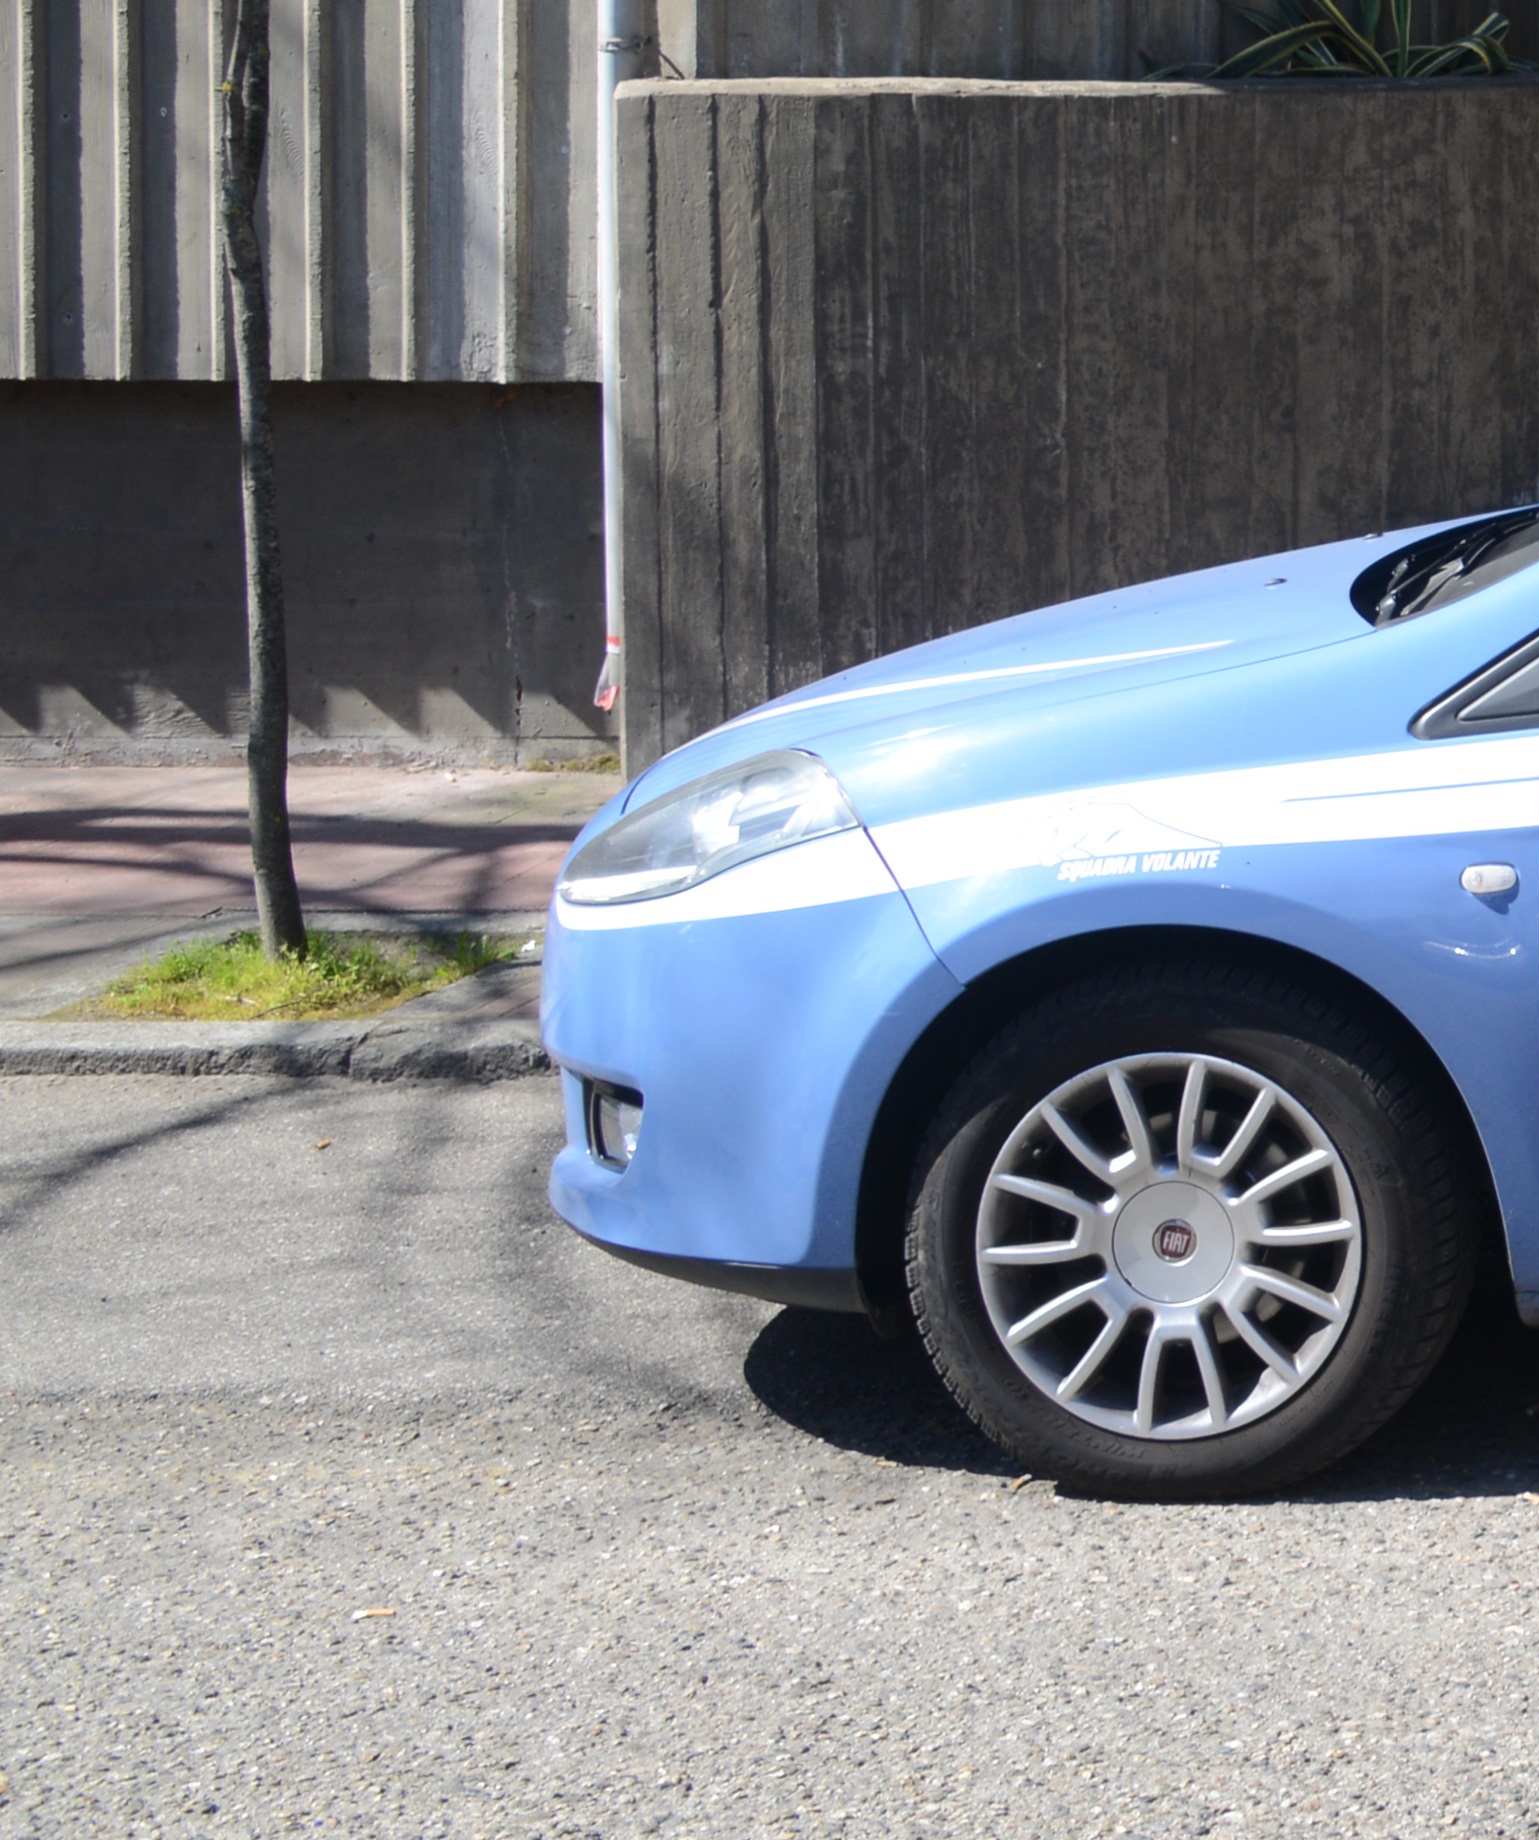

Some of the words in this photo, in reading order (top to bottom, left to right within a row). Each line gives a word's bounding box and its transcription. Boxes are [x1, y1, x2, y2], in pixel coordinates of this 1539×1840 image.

[1057, 855, 1137, 883] SQUADRA
[1141, 849, 1222, 873] VOLANTE
[1162, 1230, 1190, 1254] FIAT
